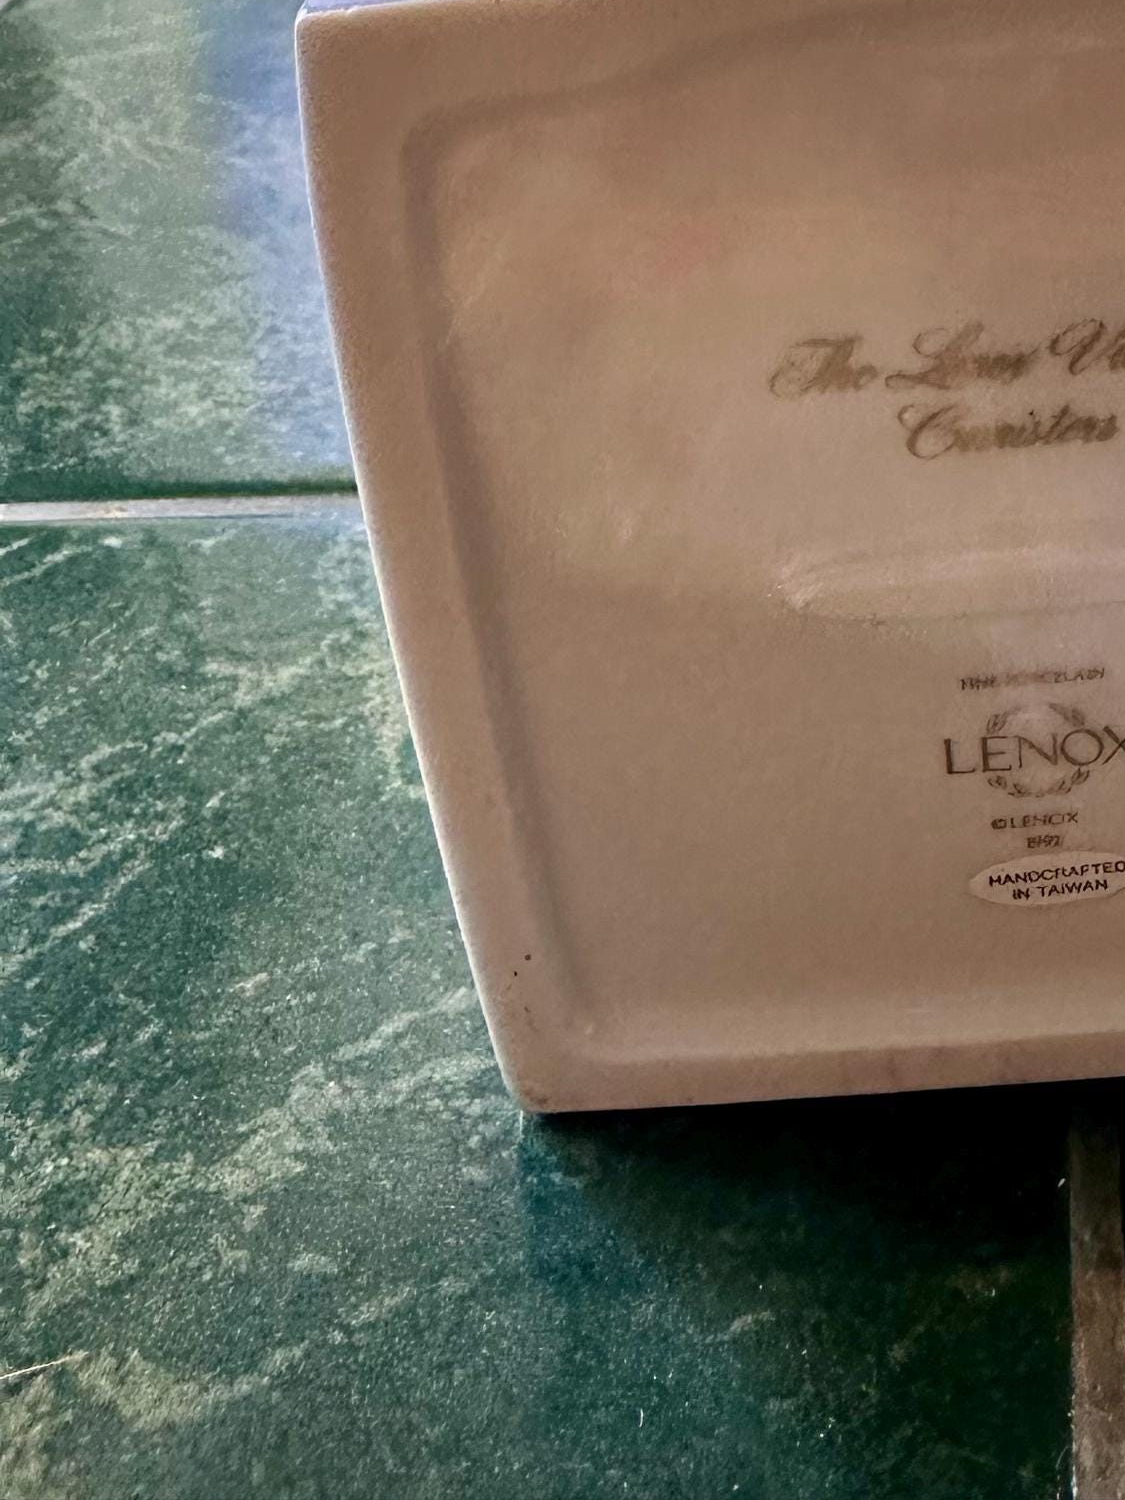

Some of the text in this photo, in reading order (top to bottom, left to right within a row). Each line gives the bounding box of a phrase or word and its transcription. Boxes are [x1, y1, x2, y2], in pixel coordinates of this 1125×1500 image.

[769, 334, 882, 398] The
[1012, 879, 1110, 901] IN TAIWAN
